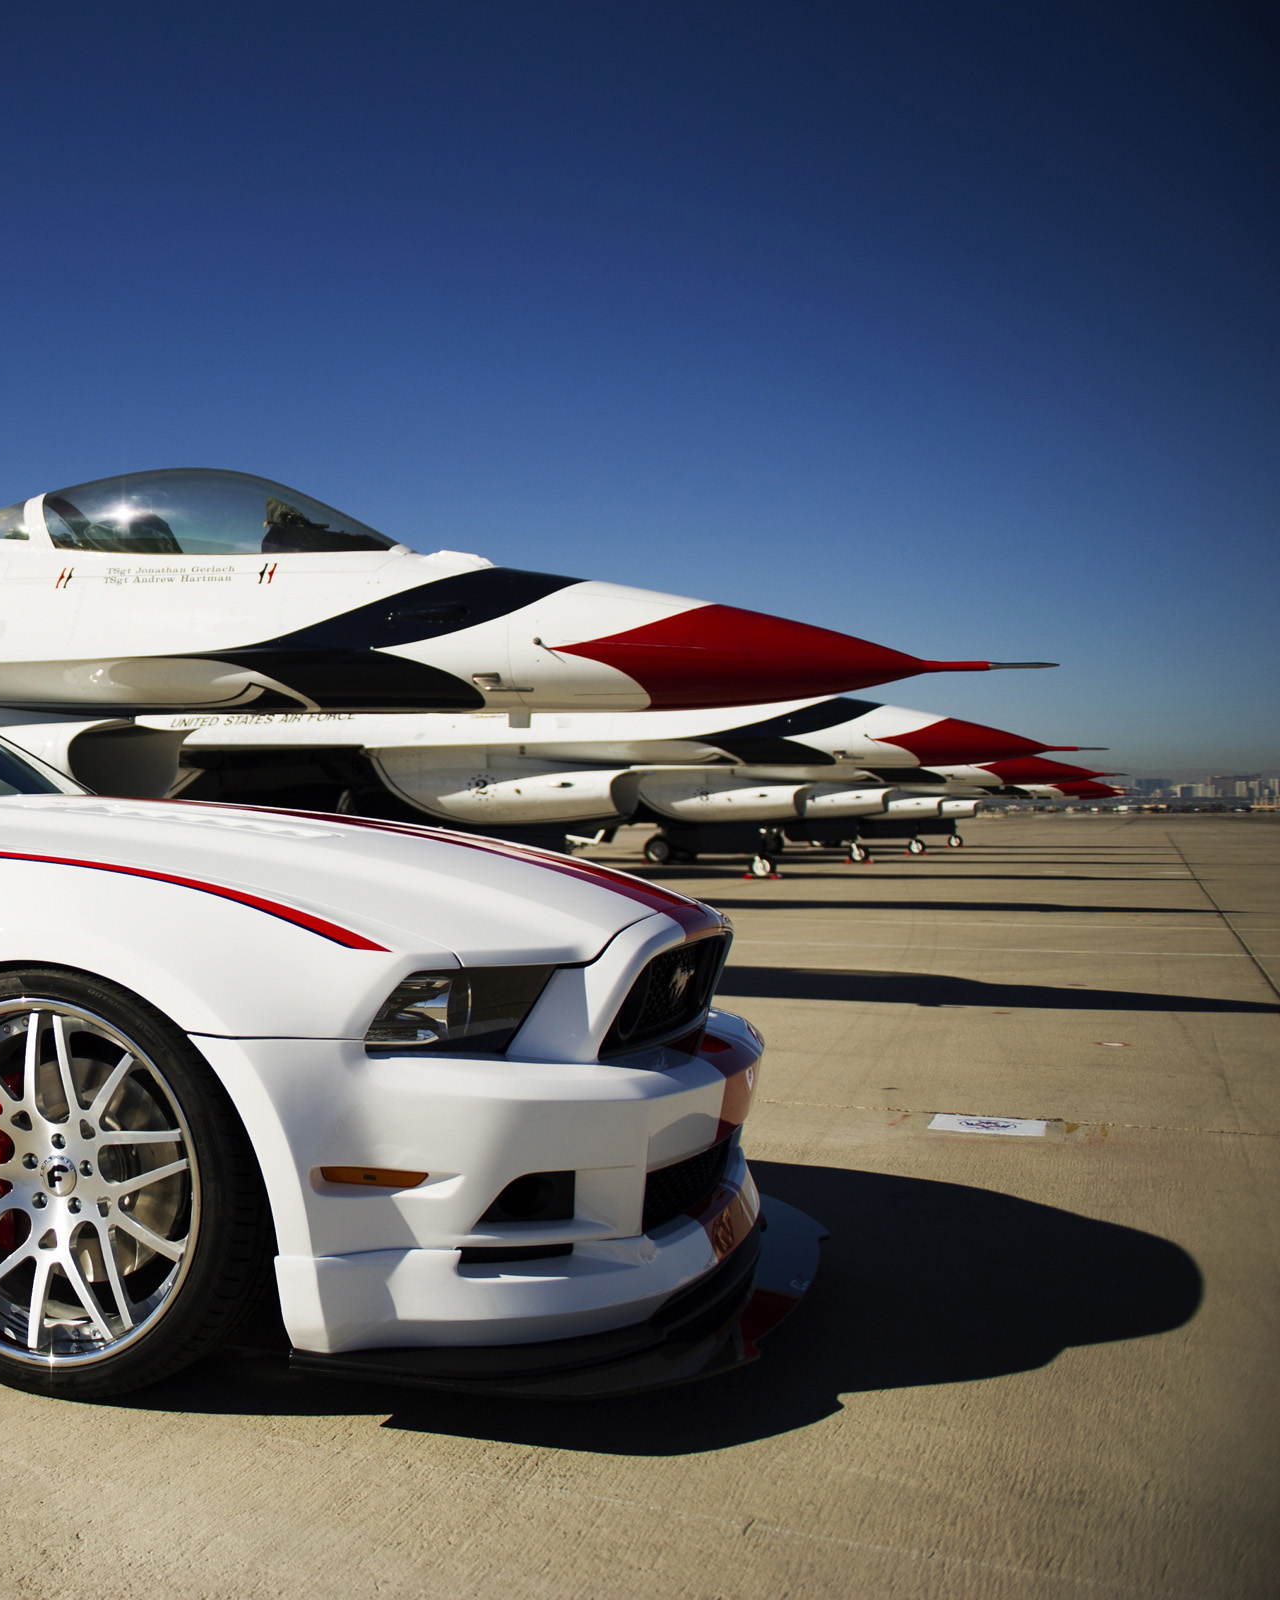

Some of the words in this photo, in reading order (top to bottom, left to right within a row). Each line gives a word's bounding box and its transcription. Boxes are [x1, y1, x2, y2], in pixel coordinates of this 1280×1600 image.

[136, 566, 186, 574] Jonathan
[191, 565, 235, 573] Gerlach
[133, 576, 176, 584] Andrew
[180, 575, 232, 583] Hartman
[170, 716, 219, 728] UNITED
[223, 714, 273, 726] STATES
[279, 713, 303, 723] AIR
[307, 713, 356, 722] FORCE
[475, 779, 489, 795] 2
[47, 1164, 69, 1188] F
